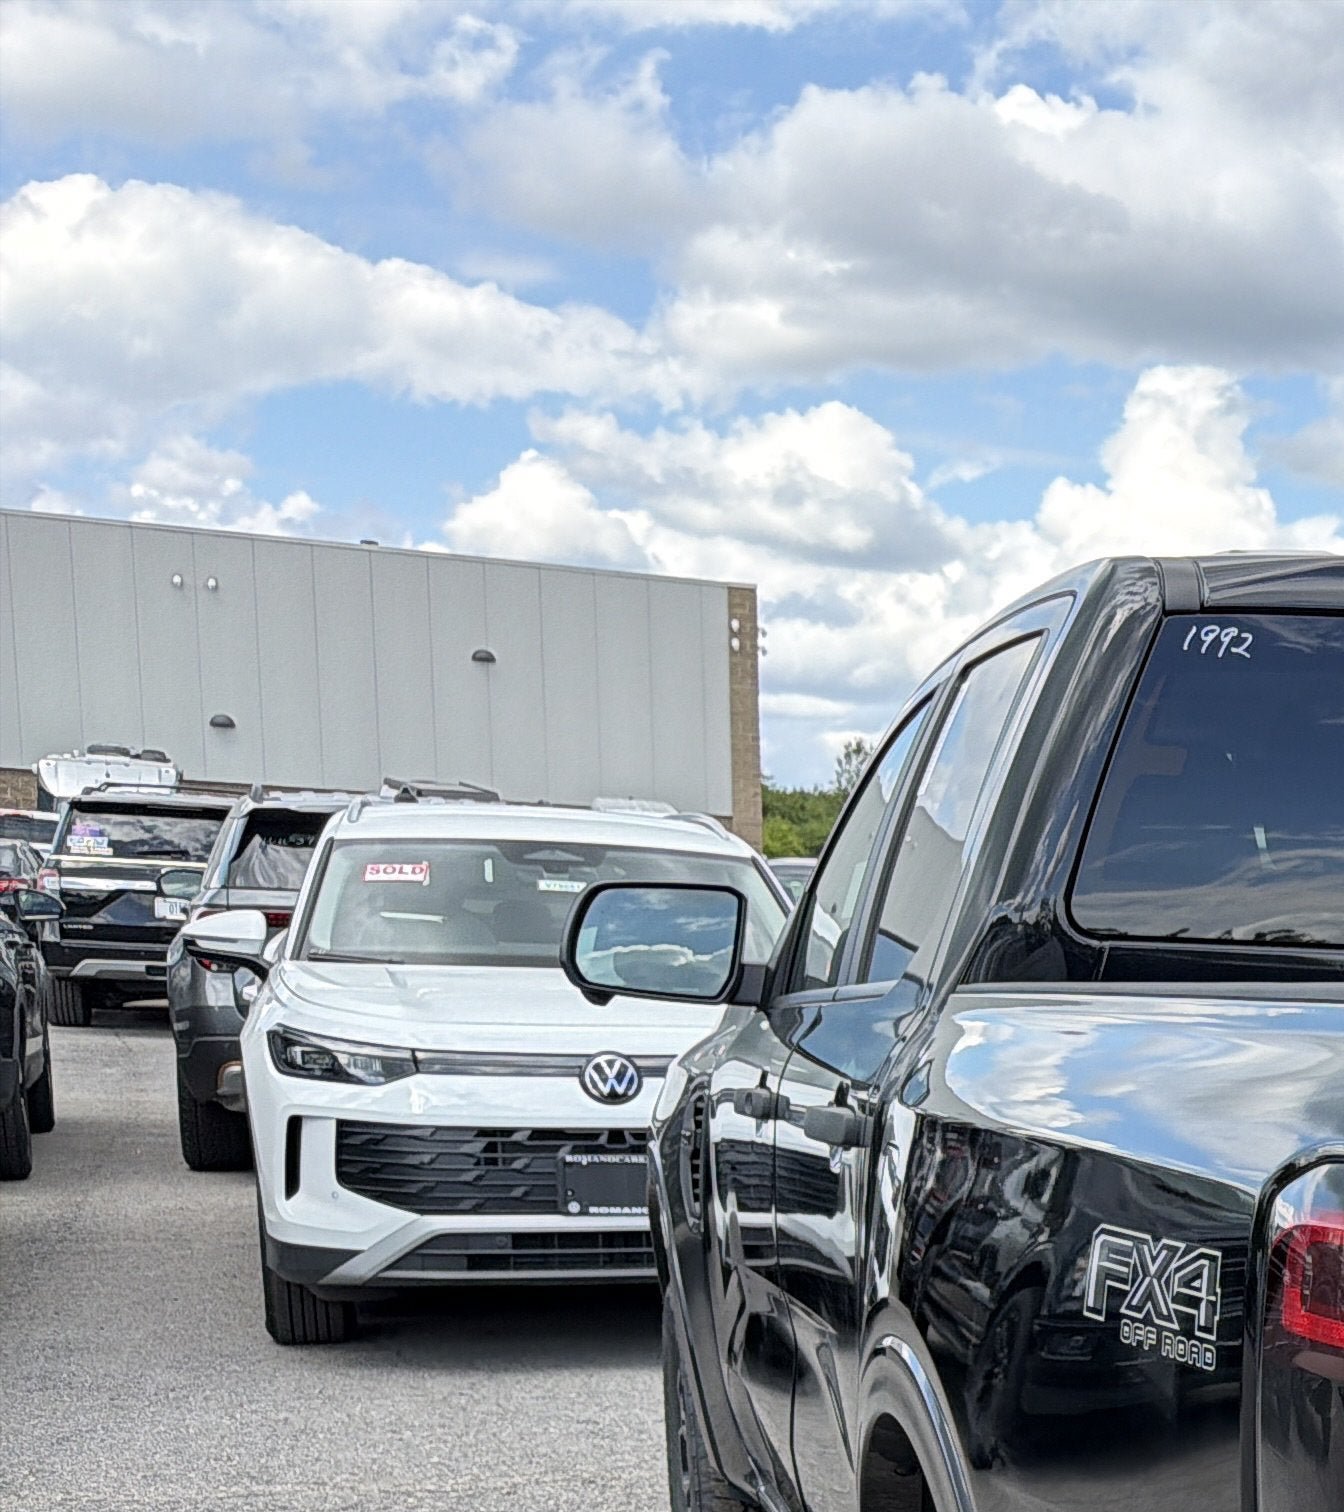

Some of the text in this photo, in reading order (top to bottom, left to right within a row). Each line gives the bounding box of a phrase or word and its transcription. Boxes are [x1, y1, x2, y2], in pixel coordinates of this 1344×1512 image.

[1183, 625, 1253, 658] 1992
[368, 866, 425, 876] SOLD
[1082, 1223, 1222, 1341] FX4
[1119, 1318, 1217, 1372] OFF ROAD
